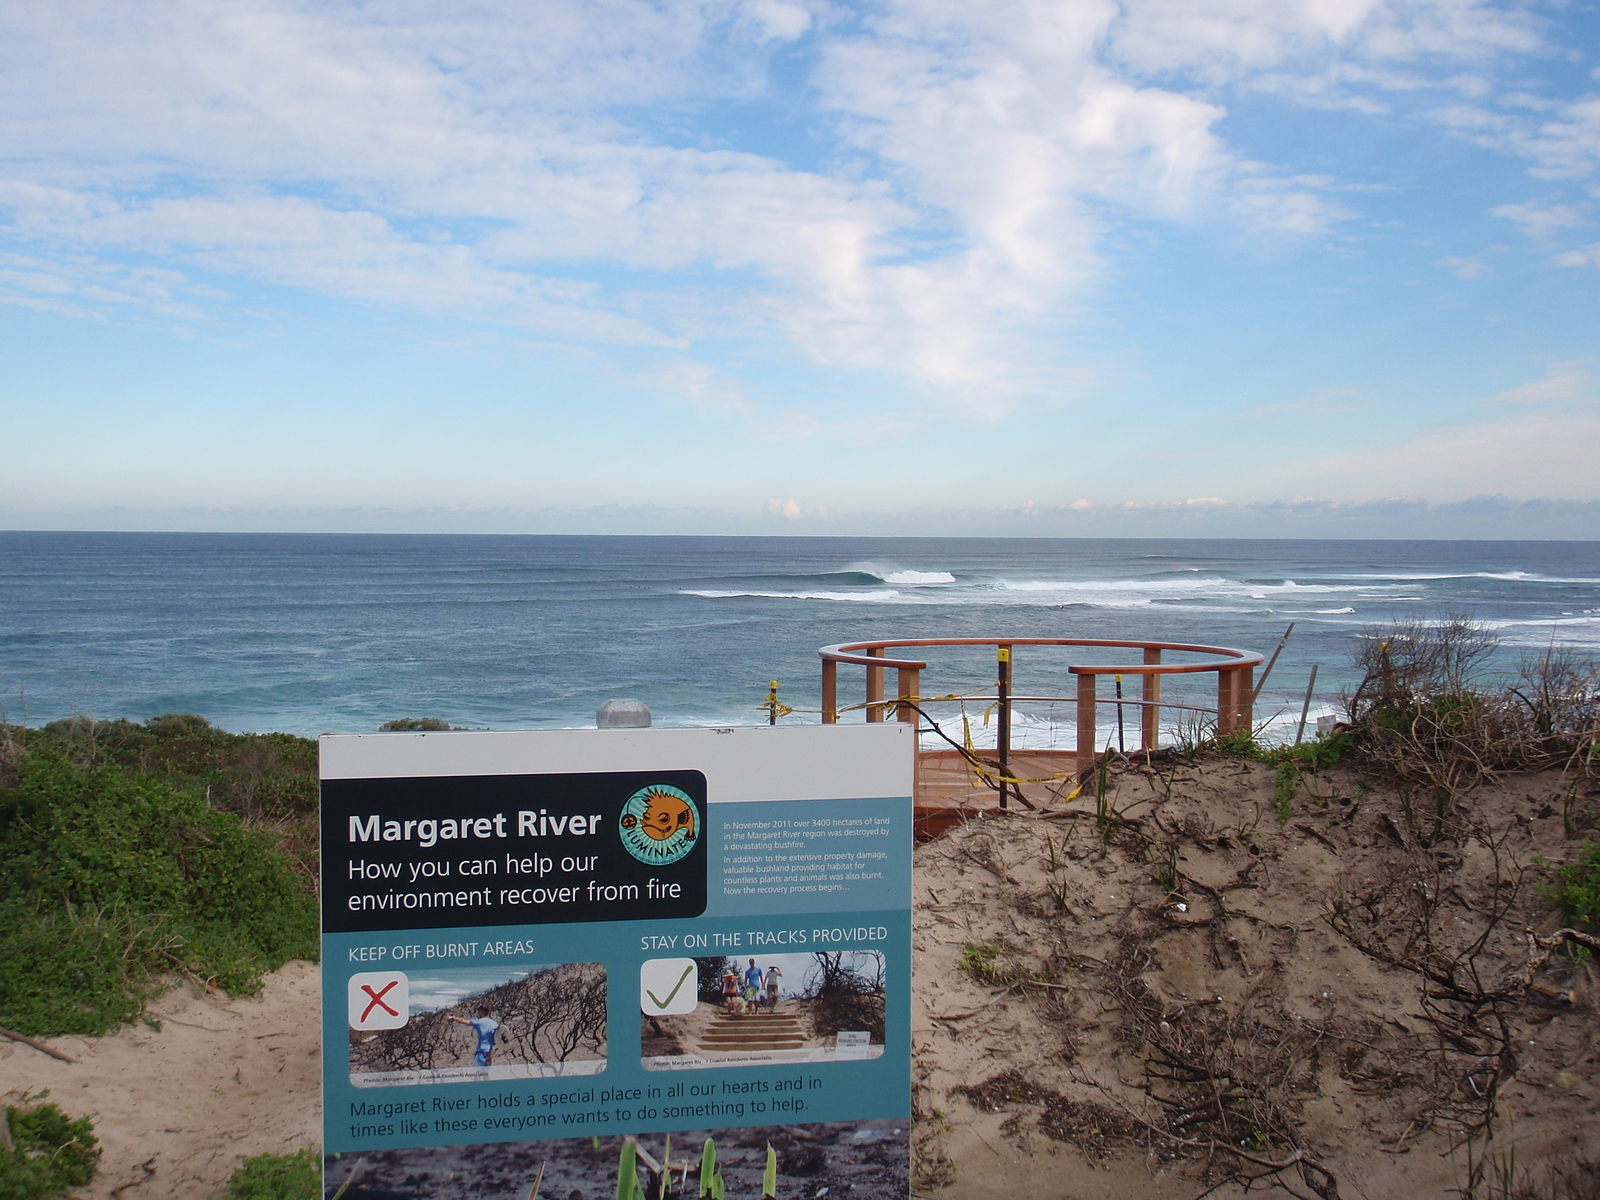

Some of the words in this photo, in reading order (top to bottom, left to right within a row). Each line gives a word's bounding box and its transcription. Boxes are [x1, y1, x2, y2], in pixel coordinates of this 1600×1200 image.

[349, 813, 507, 847] Margaret
[518, 809, 602, 837] River
[733, 821, 771, 829] November
[772, 820, 791, 828] 2011
[812, 819, 831, 827] 3400
[864, 817, 872, 825] of
[874, 817, 890, 825] land
[626, 829, 687, 857] LUMINATE
[733, 832, 745, 840] the
[747, 832, 781, 841] Margaret
[783, 830, 801, 838] River
[802, 831, 826, 839] region
[844, 827, 879, 837] destroyed
[881, 827, 890, 836] by
[730, 842, 772, 851] devastating
[774, 840, 806, 849] bushfire.
[349, 859, 402, 879] How
[409, 861, 449, 883] you
[459, 860, 496, 875] can
[507, 852, 553, 876] help
[561, 856, 598, 872] our
[723, 865, 754, 874] valuable
[756, 864, 789, 873] bushland
[791, 863, 825, 873] providing
[827, 862, 853, 870] habitat
[854, 861, 865, 869] for
[732, 855, 763, 863] addition
[775, 854, 787, 862] the
[824, 853, 855, 861] property
[856, 851, 888, 860] damage,
[723, 876, 758, 884] countless
[760, 875, 782, 884] plants
[784, 874, 798, 882] and
[799, 873, 827, 882] animals
[845, 872, 860, 880] also
[348, 887, 492, 911] environment
[500, 887, 580, 904] recover
[587, 880, 638, 901] from
[646, 878, 681, 899] fire
[724, 887, 741, 895] Now
[743, 886, 755, 894] the
[789, 885, 817, 894] process
[641, 935, 678, 950] STAY
[684, 934, 707, 948] ON
[712, 933, 741, 947] THE
[747, 930, 807, 945] TRACKS
[813, 927, 887, 942] PROVIDED
[349, 947, 387, 961] KEEP
[392, 945, 420, 959] OFF
[426, 942, 479, 958] BURNT
[483, 940, 534, 955] AREAS
[351, 1100, 426, 1118] Margaret
[433, 1097, 471, 1111] River
[478, 1092, 520, 1109] holds
[527, 1095, 535, 1106] a
[541, 1088, 594, 1108] special
[601, 1086, 641, 1105] place
[648, 1085, 661, 1098] in
[667, 1083, 684, 1097] all
[690, 1084, 716, 1096] our
[722, 1080, 769, 1094] hearts
[775, 1076, 802, 1091] and
[809, 1075, 821, 1089] in
[350, 1123, 394, 1138] times
[401, 1119, 428, 1134] like
[435, 1117, 477, 1132] these
[484, 1115, 556, 1131] everyone
[562, 1110, 609, 1124] wants
[616, 1109, 631, 1121] to
[637, 1105, 657, 1120] do
[663, 1101, 744, 1118] something
[750, 1100, 766, 1113] to
[772, 1096, 808, 1113] help.
